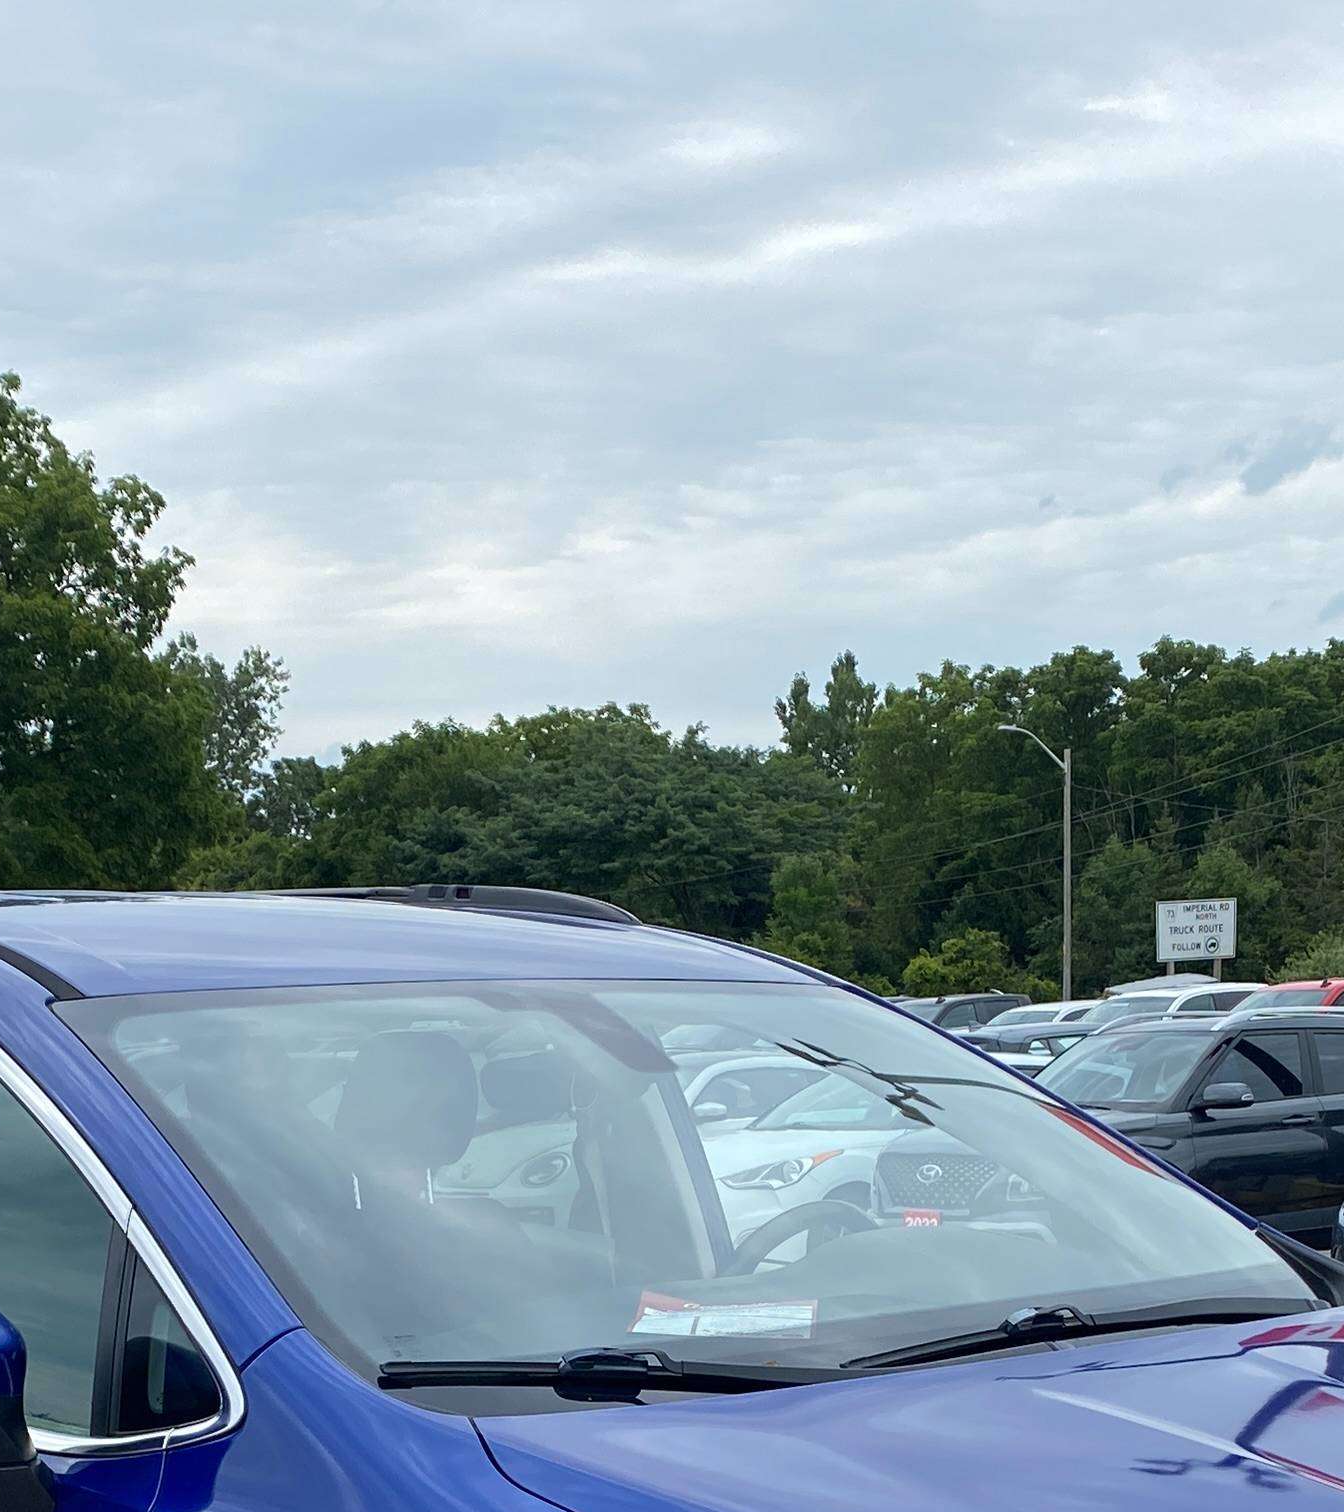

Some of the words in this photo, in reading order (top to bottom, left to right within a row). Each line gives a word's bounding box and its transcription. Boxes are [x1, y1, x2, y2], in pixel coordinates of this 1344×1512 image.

[1183, 904, 1217, 912] IMPERIAL
[1219, 903, 1230, 911] RD
[1169, 926, 1194, 935] TRUCK
[1198, 924, 1223, 933] ROUTE
[1172, 942, 1201, 951] FOLLOW
